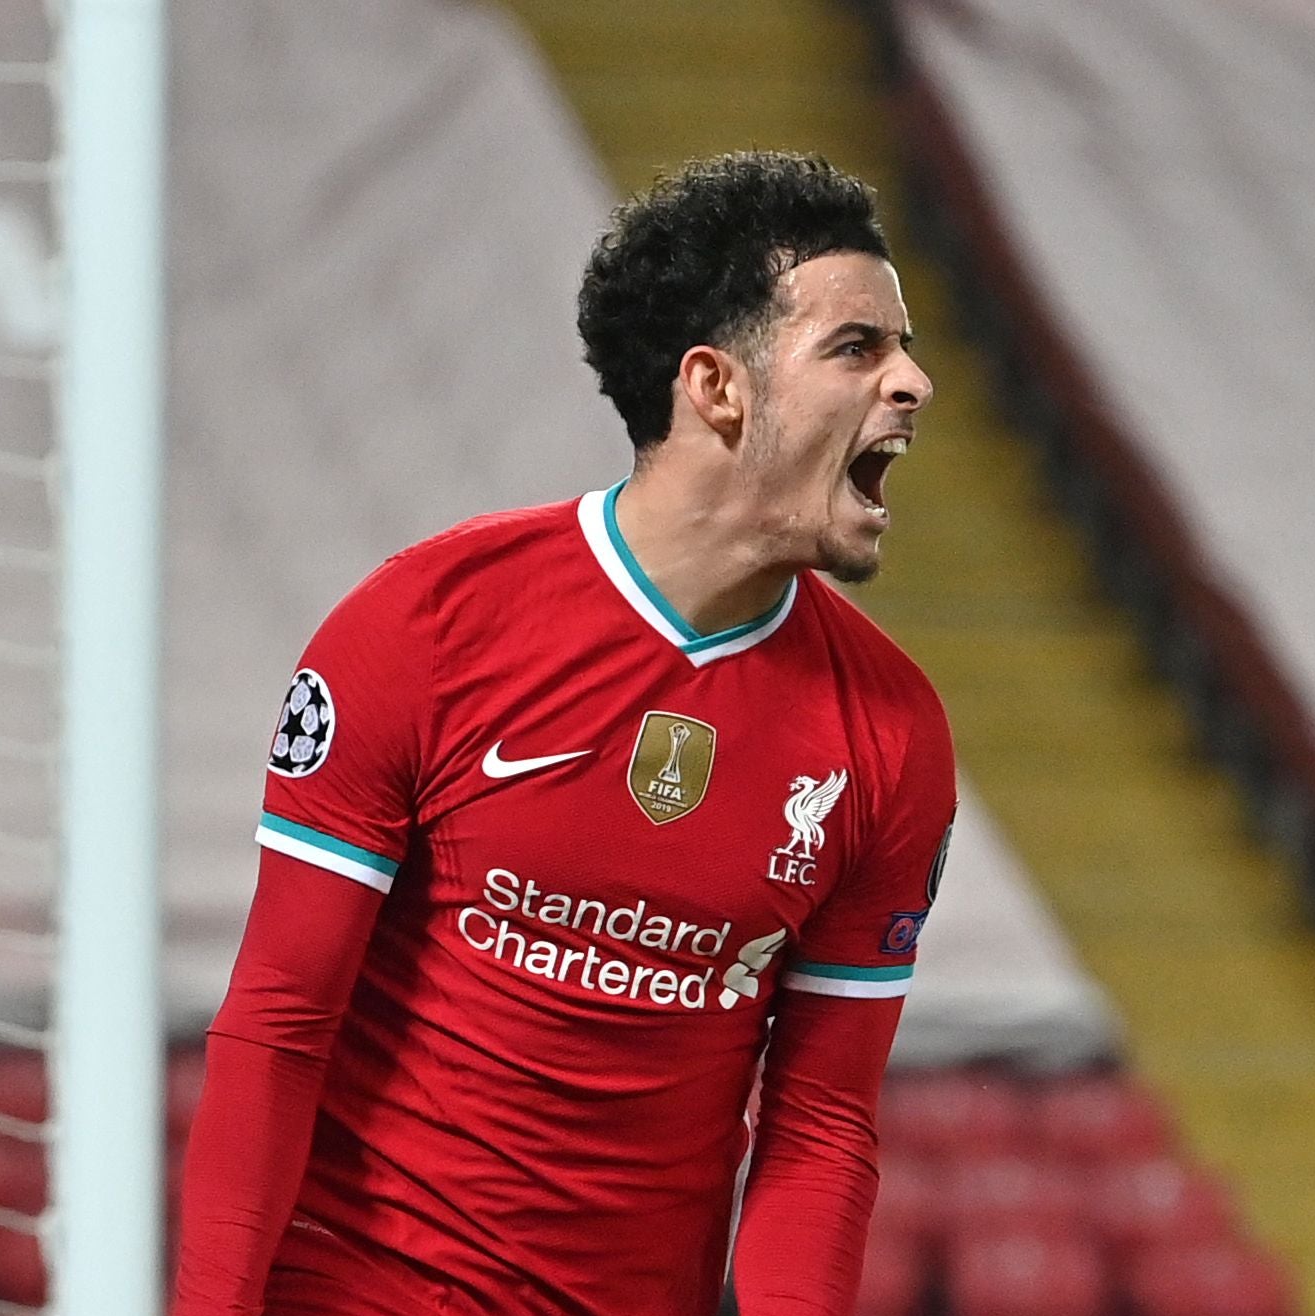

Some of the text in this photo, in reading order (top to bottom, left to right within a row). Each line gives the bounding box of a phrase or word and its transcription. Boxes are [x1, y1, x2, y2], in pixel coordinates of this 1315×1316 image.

[648, 780, 682, 800] FIFA
[767, 855, 817, 886] L.F.C.
[483, 867, 732, 958] Standard
[457, 906, 715, 1010] Chartered
